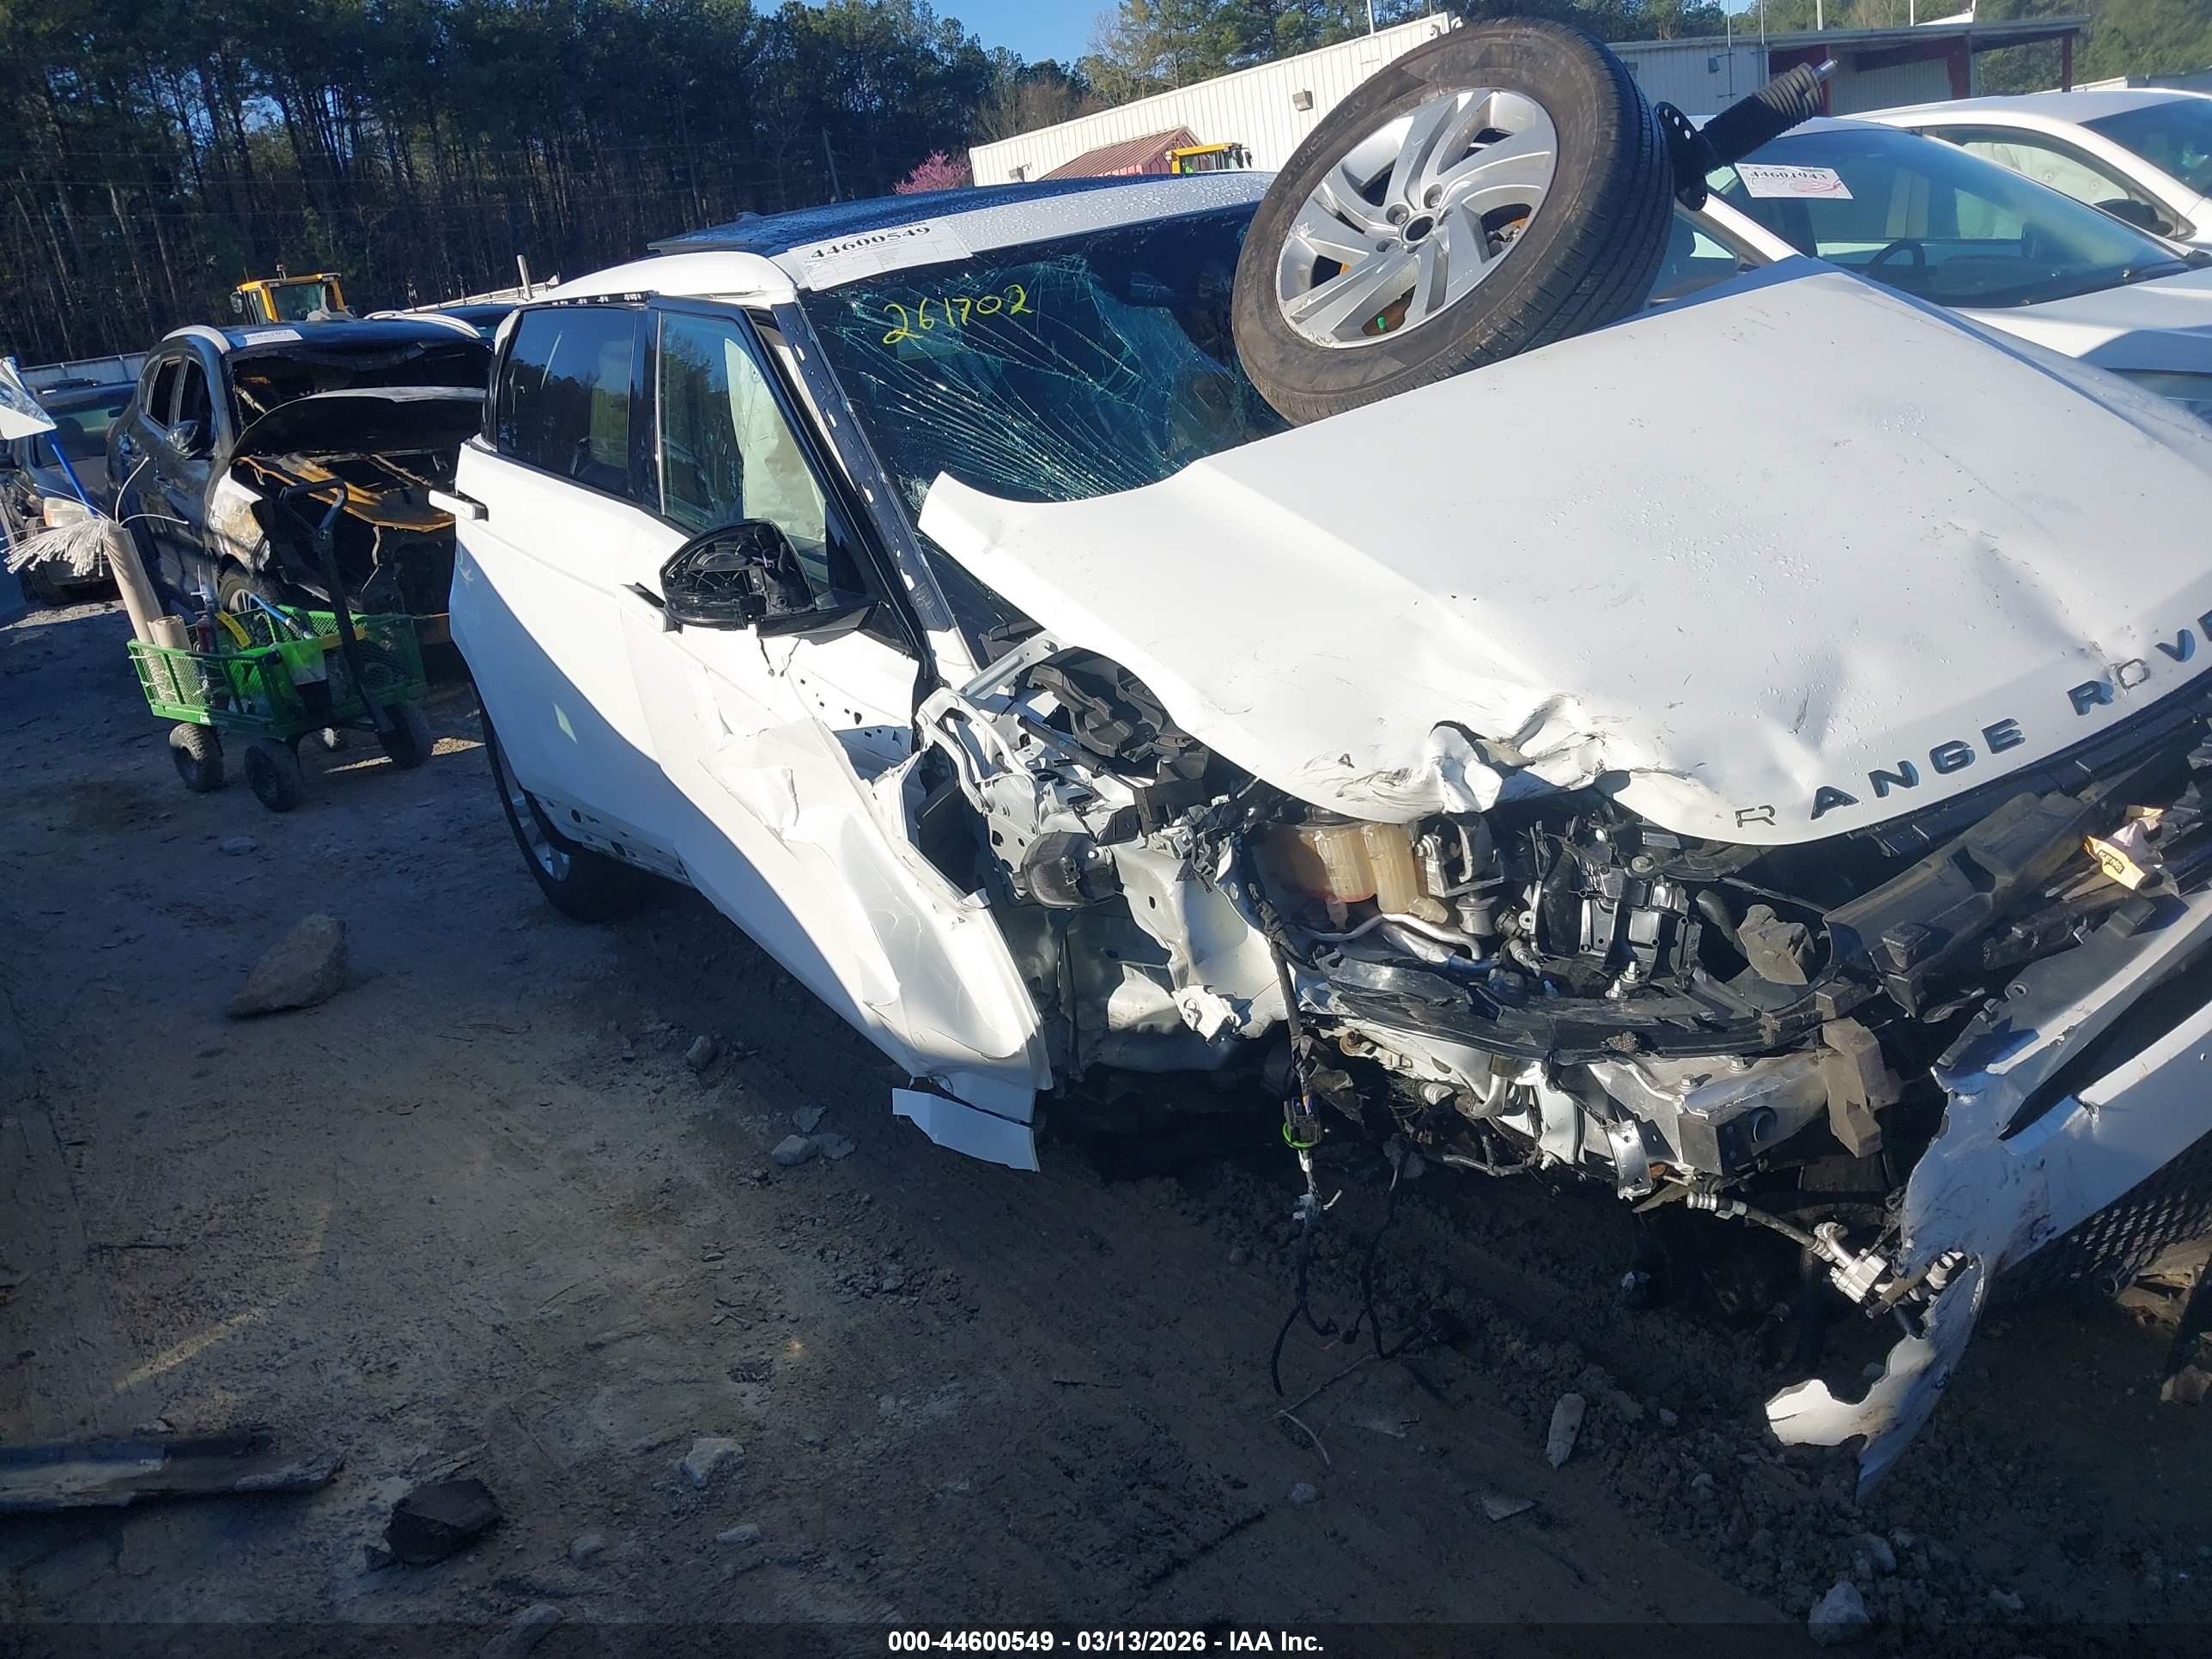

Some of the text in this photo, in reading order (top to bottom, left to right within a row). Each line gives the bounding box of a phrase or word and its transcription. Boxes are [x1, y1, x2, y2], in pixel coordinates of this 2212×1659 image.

[811, 227, 931, 259] 44600549
[883, 284, 1035, 344] 261702
[1735, 718, 2027, 829] RANGE
